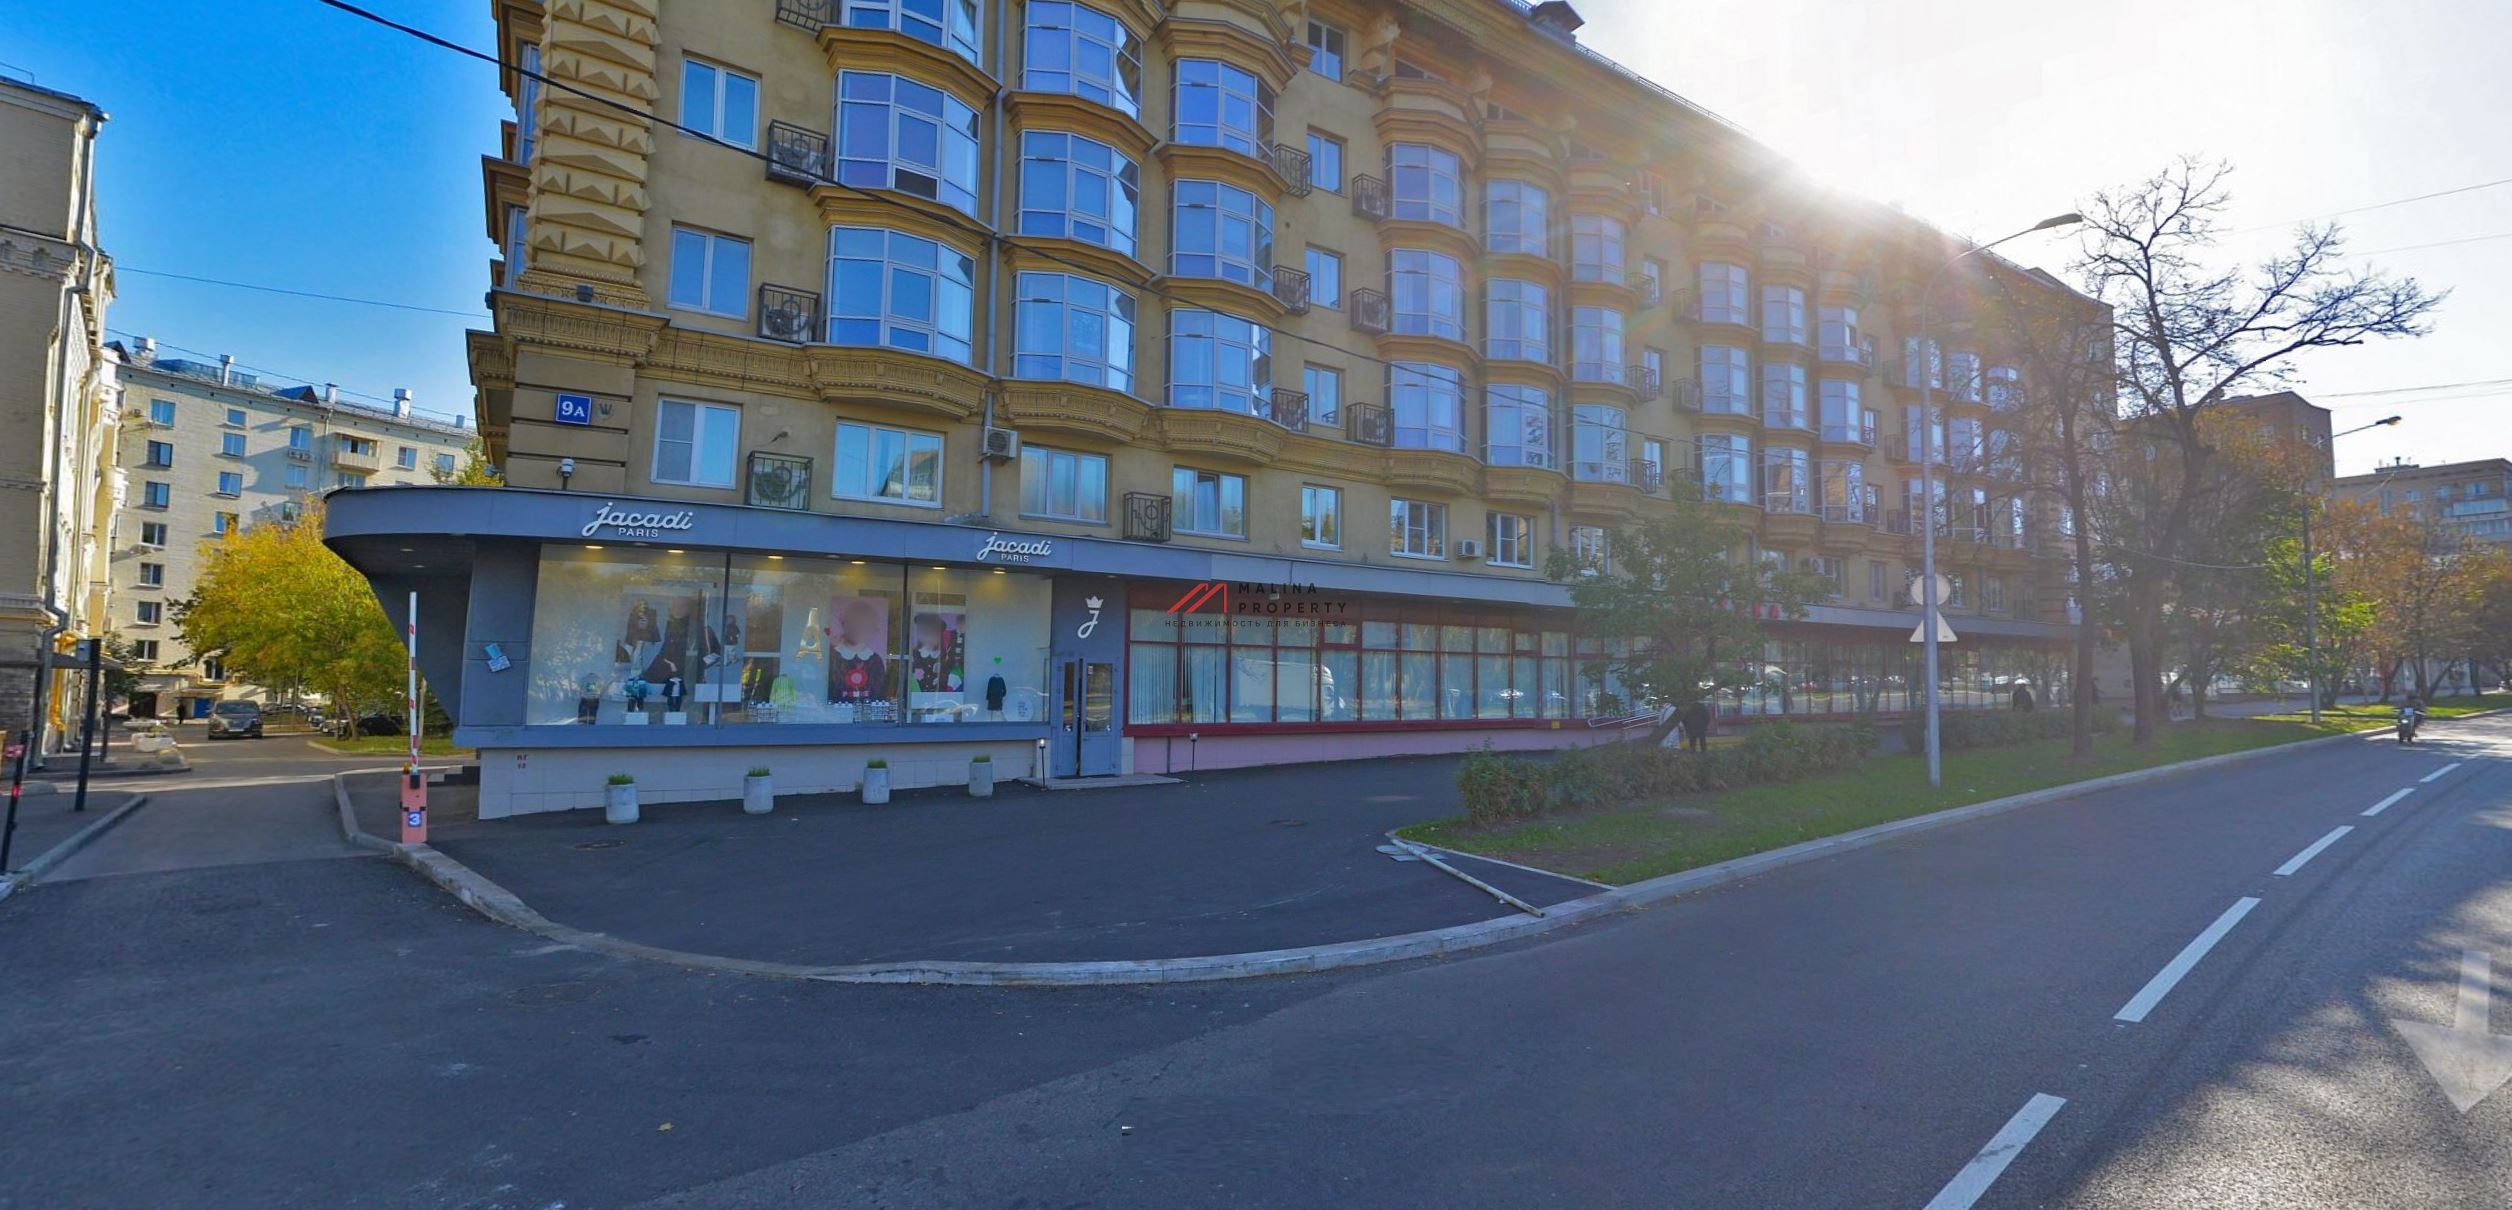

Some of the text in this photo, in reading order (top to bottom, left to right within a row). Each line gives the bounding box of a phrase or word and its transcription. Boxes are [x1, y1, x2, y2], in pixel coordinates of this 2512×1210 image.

[562, 401, 585, 417] 9А
[581, 501, 693, 537] jacadi
[618, 527, 659, 538] PARIS
[976, 531, 1052, 561] jacadi
[1001, 553, 1029, 563] PARIS
[409, 813, 420, 825] 3
